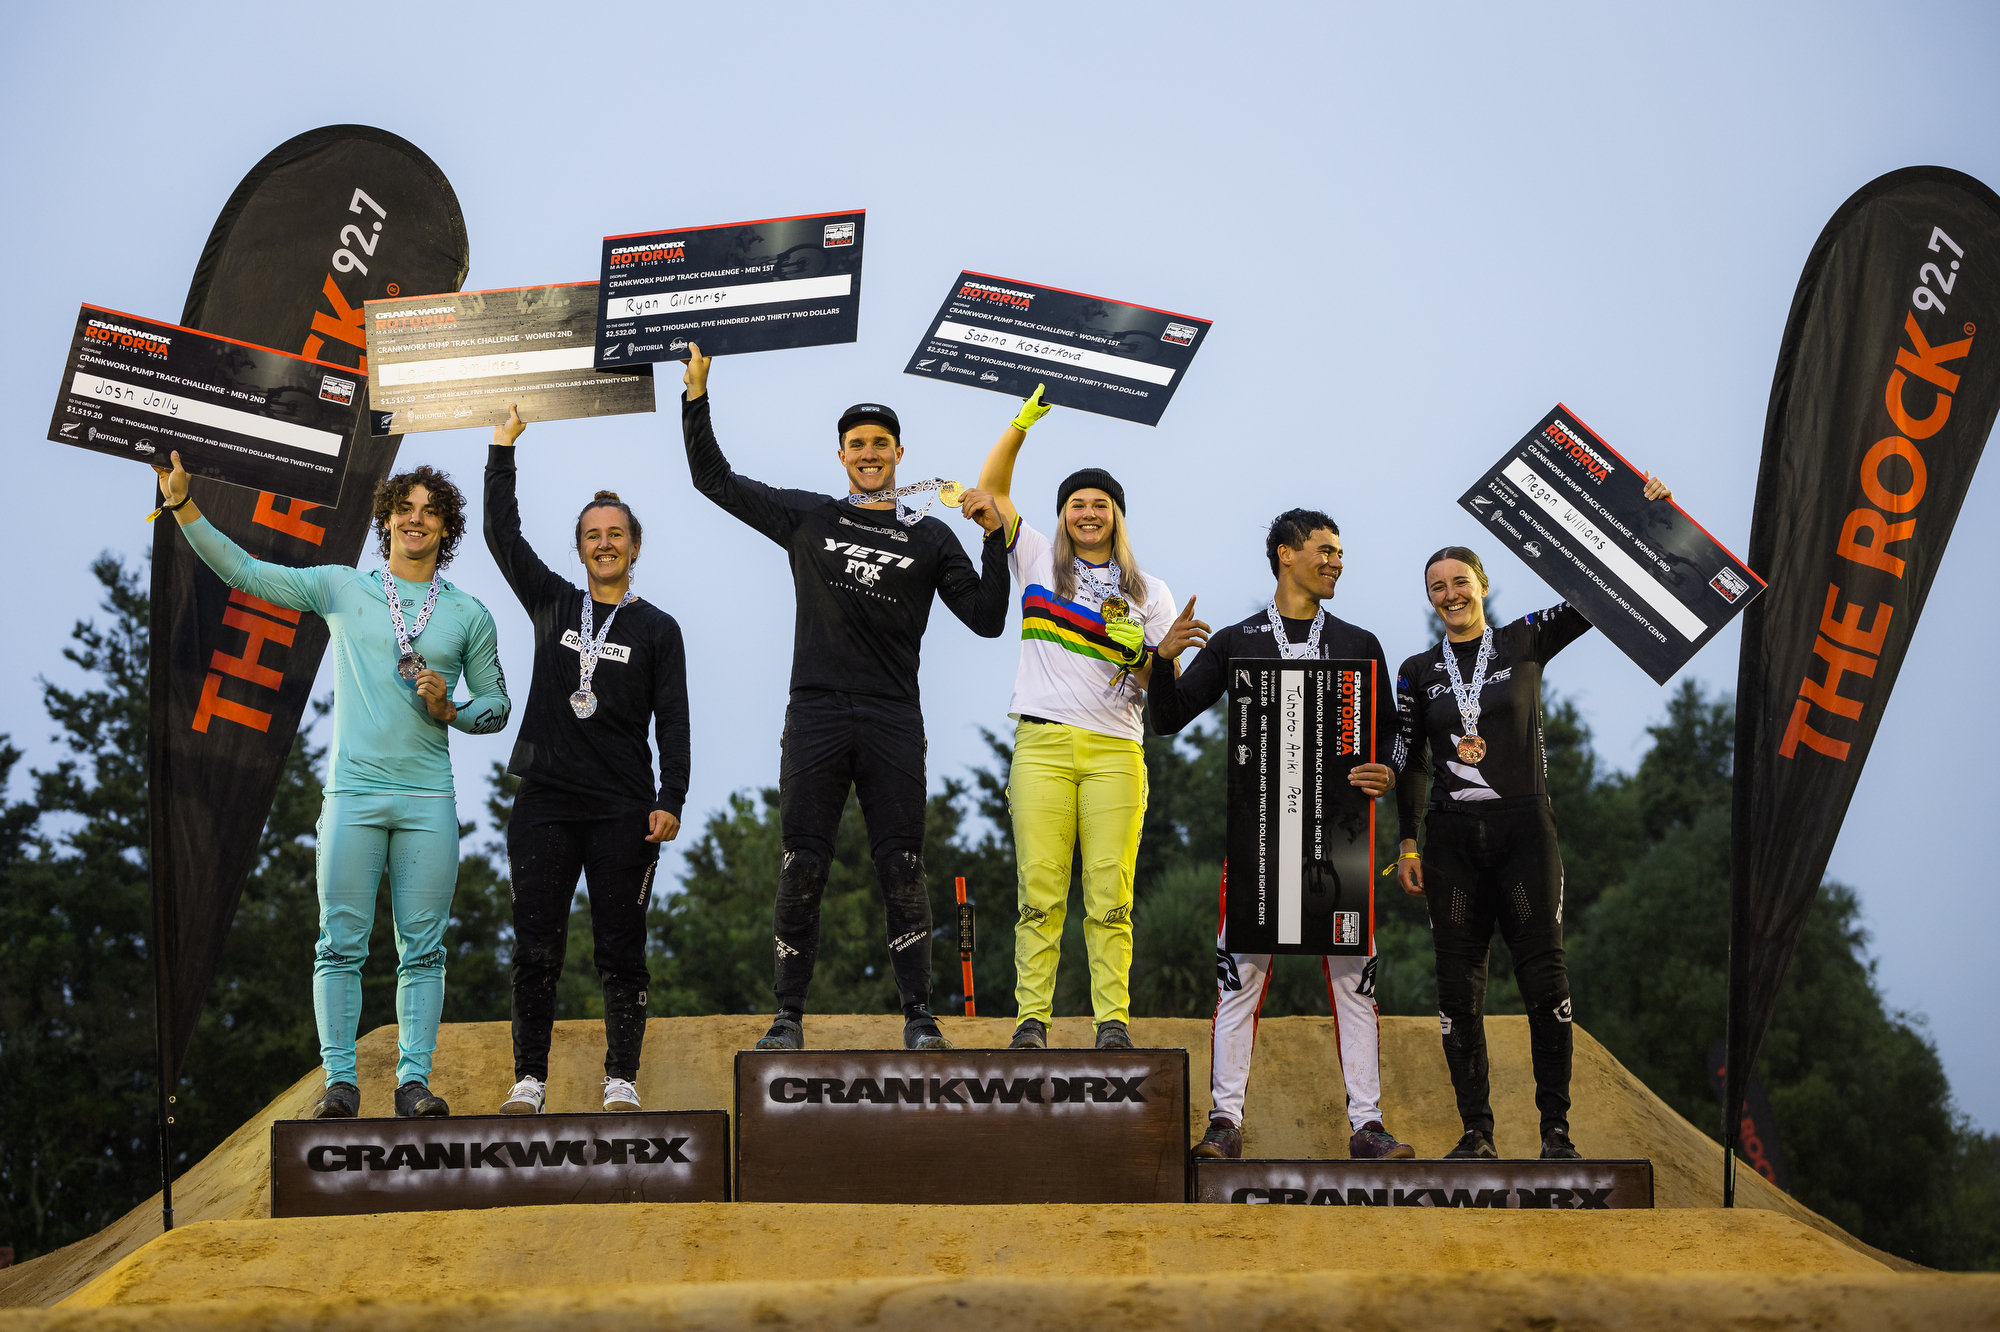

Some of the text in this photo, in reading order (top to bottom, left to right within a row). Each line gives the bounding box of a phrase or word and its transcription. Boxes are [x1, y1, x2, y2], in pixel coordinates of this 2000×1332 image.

[331, 187, 387, 276] 92.7
[610, 248, 684, 265] ROTORUA
[611, 240, 685, 255] CRANKWORX
[609, 264, 775, 288] CRANKWORX PUMP TRACK CHALLENGE MEN 1ST
[625, 292, 727, 315] Ryan Gilchrist
[959, 286, 1030, 308] ROTORUA
[964, 281, 1036, 300] CRANKWORX
[375, 306, 457, 320] CRANKWORX
[375, 313, 457, 331] ROTORUA
[662, 322, 700, 332] THOUSAND,
[701, 320, 716, 328] FIVE
[716, 317, 750, 326] HUNDRED
[750, 315, 766, 323] AND
[766, 312, 791, 321] THIRTY
[791, 310, 809, 318] TWO
[809, 307, 840, 317] DOLLARS
[88, 319, 172, 345] CRANKWORX
[605, 328, 637, 338] $2,532.00
[949, 307, 1121, 347] CRANKWORX PUMP TRACK CHALLENGE WOMEN 1ST
[964, 328, 1007, 346] Sabina
[83, 336, 168, 361] MARCH 11-15 2026
[85, 326, 168, 356] ROTORUA
[377, 330, 573, 354] CRANKWORX PUMP TRACK CHALLENGE WOMEN 2ND
[634, 344, 664, 352] ROTORUA
[79, 353, 266, 404] CRANKWORX PUMP TRACK CHALLENGE MEN 2ND
[947, 365, 976, 376] ROTORUA
[964, 353, 1149, 398] TWO THOUSAND, FIVE HUNDRED AND THIRTY TWO DOLLARS
[95, 381, 179, 416] Josh Jolly
[66, 405, 103, 420] $1,519.20
[95, 432, 129, 446] ROTORUA
[110, 416, 334, 474] ONE THOUSAND, FIVE HUNDRED AND NINETEEN DOLLARS AND TWENTY CENTS
[1545, 424, 1607, 481] ROTORUA
[1554, 419, 1615, 474] CRANKWORX
[1488, 482, 1516, 507] $1,012.80
[1778, 225, 1974, 762] THE ROCK 92.7
[1521, 473, 1606, 550] Megan Williams
[1527, 444, 1671, 572] CRANKWORX PUMP TRACK CHALLENGE WOMEN 3RD
[1497, 516, 1522, 540] ROTORUA
[823, 538, 915, 569] YETI
[845, 558, 883, 585] FOX
[1518, 509, 1668, 643] ONE THOUSAND AND TWELVE DOLLARS AND EIGHTY CENTS
[1260, 670, 1269, 707] $1,012.80
[1316, 670, 1324, 722] CRANKWORX
[1240, 704, 1248, 738] ROTORUA
[1260, 714, 1268, 731] ONE
[1341, 670, 1354, 755] ROTORUA
[1353, 671, 1361, 755] CRANKWORX
[1315, 747, 1323, 774] TRACK
[1259, 792, 1267, 822] TWELVE
[1287, 786, 1302, 814] Pene
[1315, 774, 1323, 819] CHALLENGE
[1314, 844, 1322, 860] 3RD
[1258, 874, 1266, 902] EIGHTY
[1258, 901, 1266, 925] CENTS
[769, 1076, 1149, 1104] CRANKWORX
[307, 1137, 690, 1172] CRANKWORX
